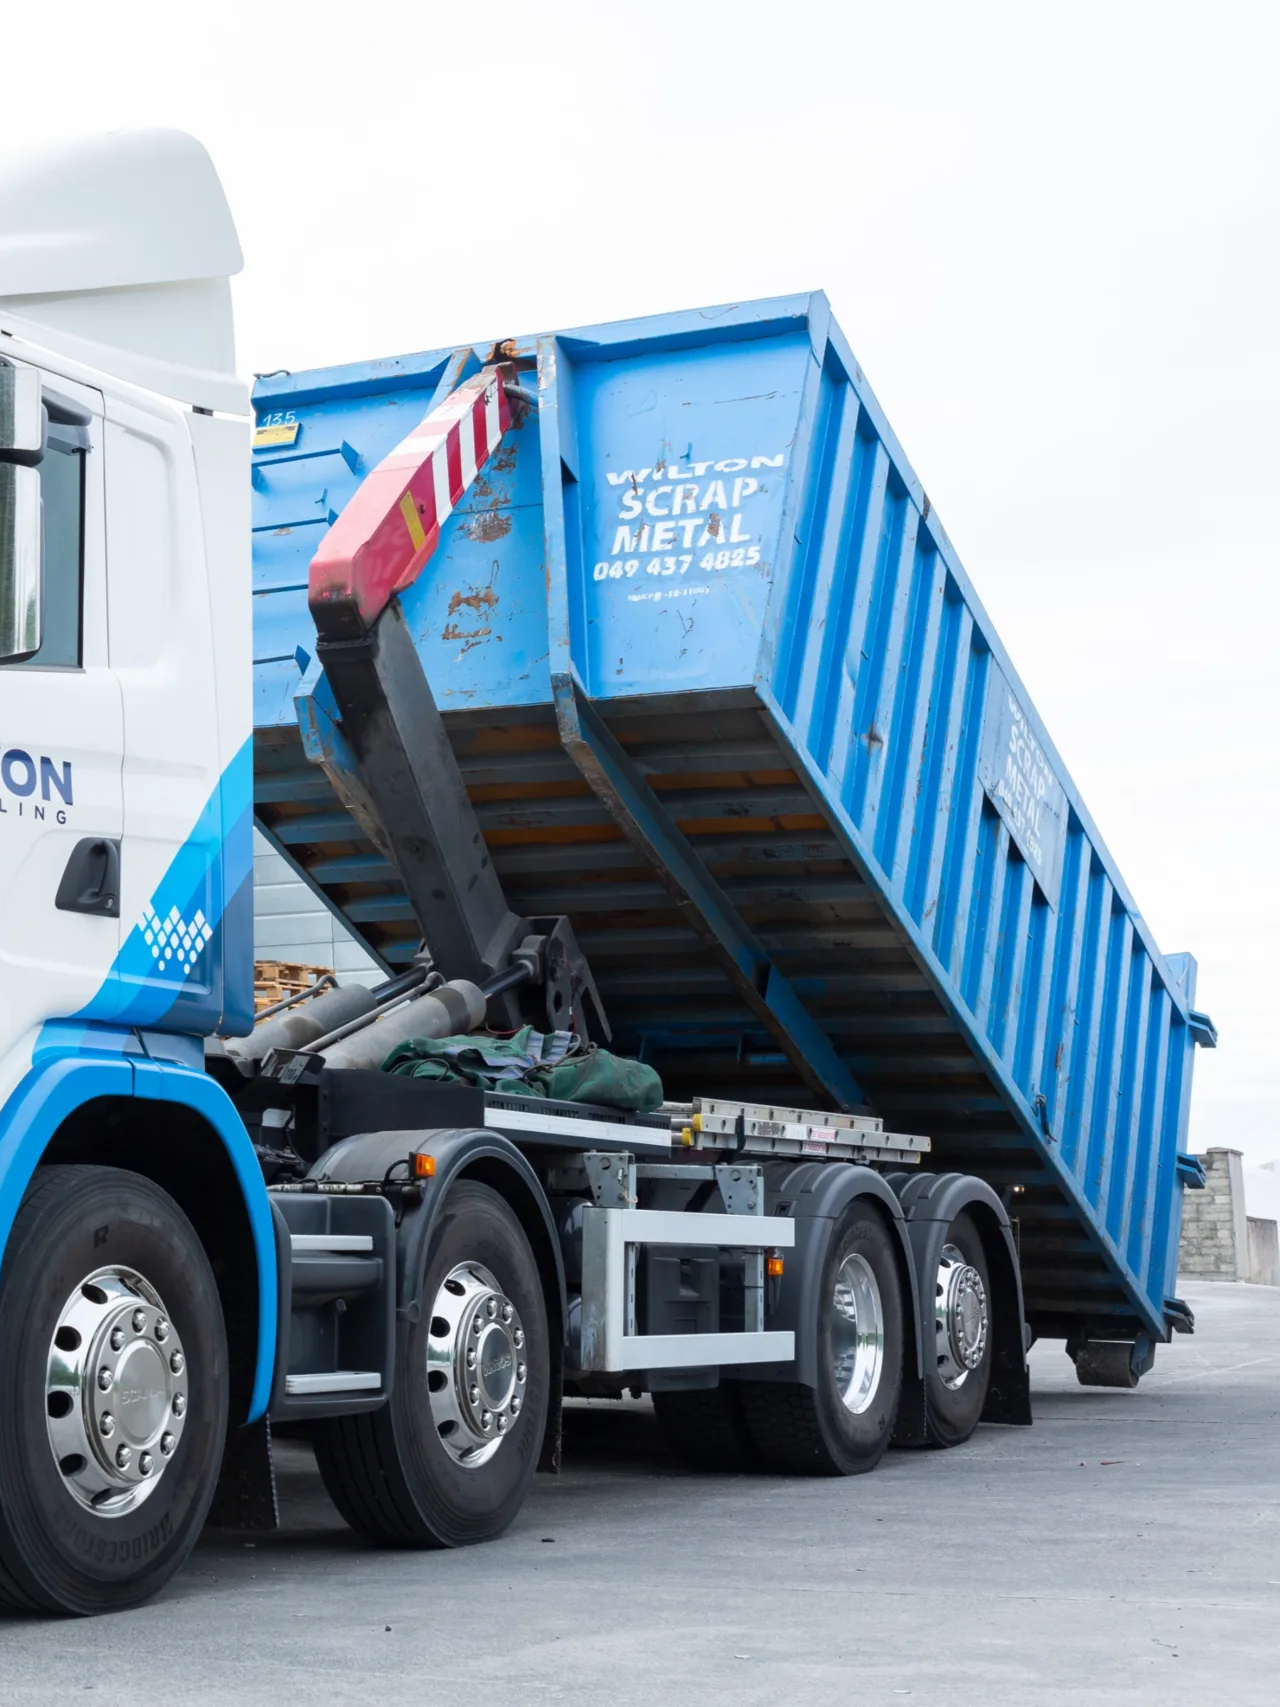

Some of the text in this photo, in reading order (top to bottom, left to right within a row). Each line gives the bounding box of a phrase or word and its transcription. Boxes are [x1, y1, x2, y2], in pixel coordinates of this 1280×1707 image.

[606, 454, 784, 486] WILTON
[618, 477, 758, 520] SCRAP
[611, 513, 750, 555] METAL
[593, 546, 761, 581] 049 437 4825
[1008, 694, 1053, 786] WILTON
[1009, 724, 1046, 798] SCRAP
[1005, 754, 1041, 837] METAL
[94, 1224, 110, 1249] R
